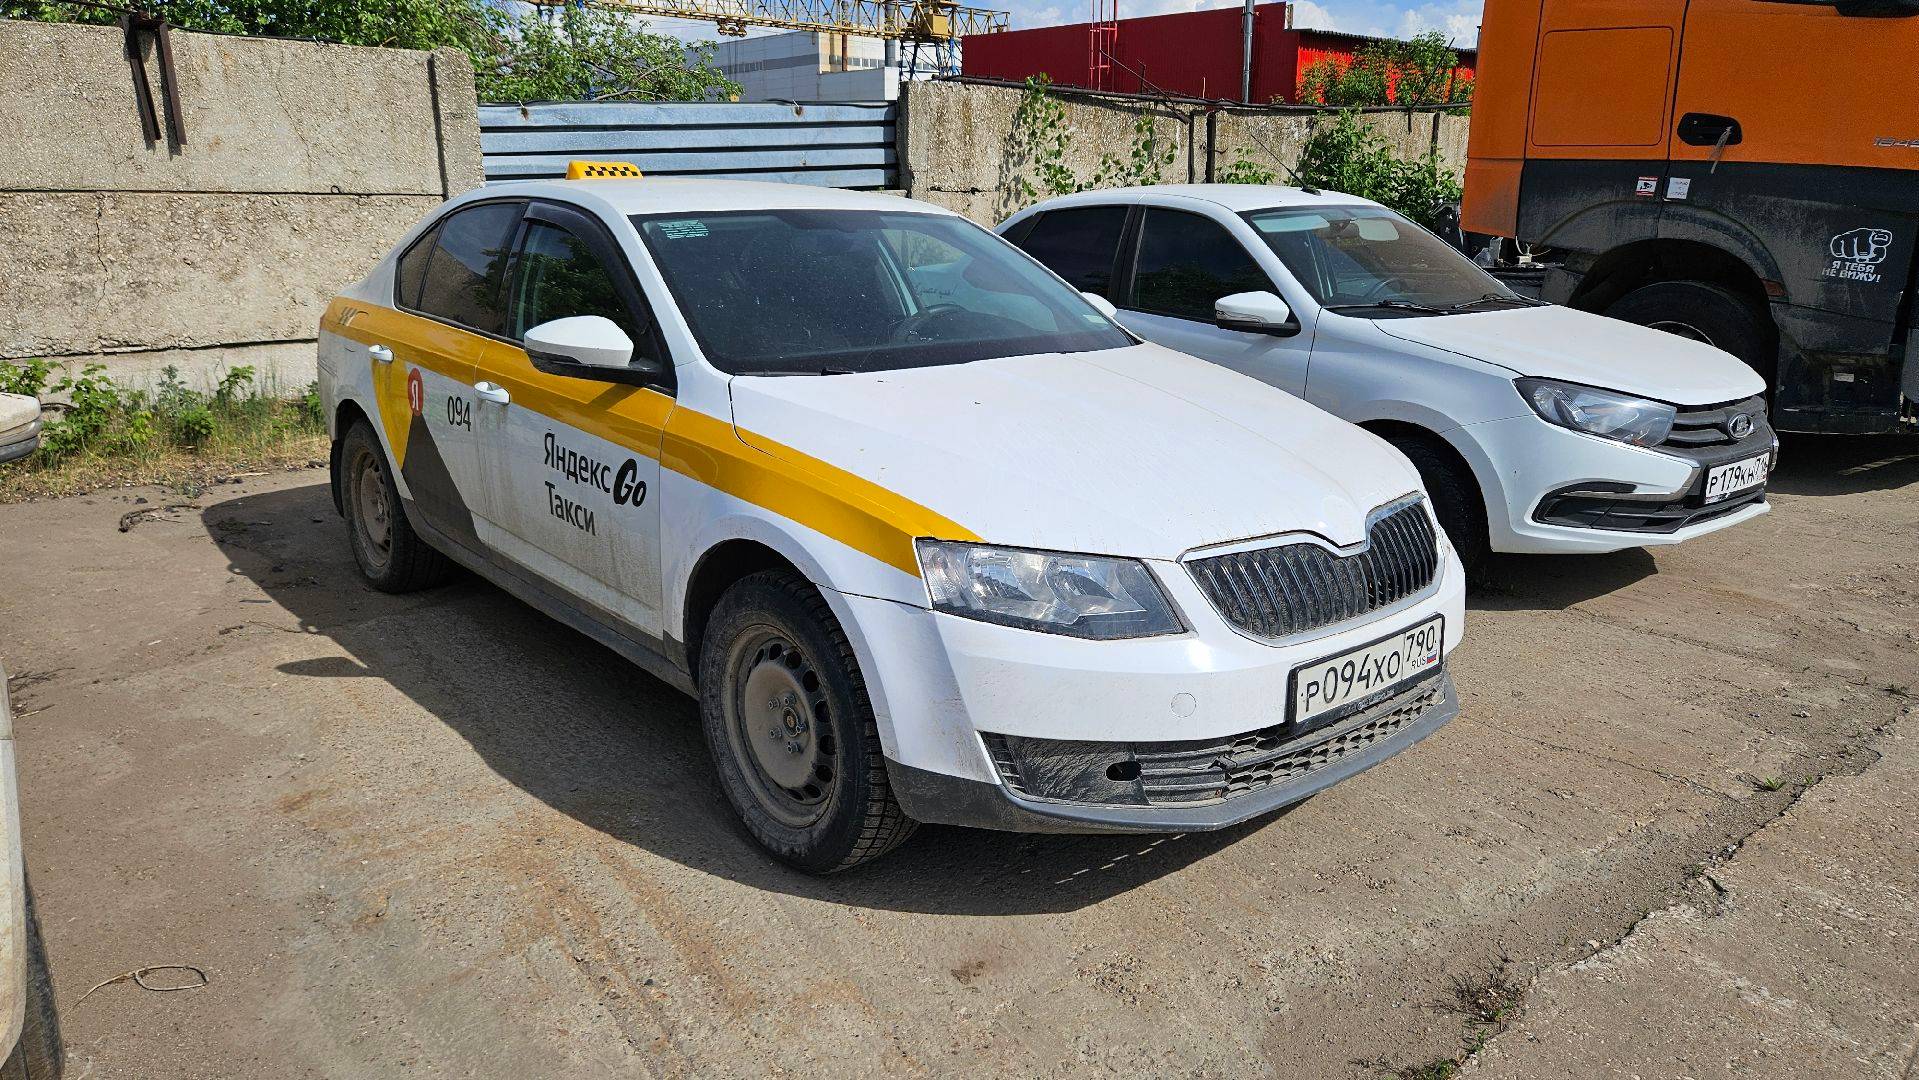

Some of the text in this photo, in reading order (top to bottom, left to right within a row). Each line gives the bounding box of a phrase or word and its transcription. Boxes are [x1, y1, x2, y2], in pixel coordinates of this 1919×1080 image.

[1821, 268, 1882, 282] НЕ ВИЖУ!
[1832, 260, 1876, 273] Я ТЕБЯ
[447, 395, 472, 432] 094
[544, 431, 647, 507] Яндекс Go
[544, 480, 596, 537] Такси
[1406, 624, 1436, 662] 790
[1411, 655, 1427, 670] RUS
